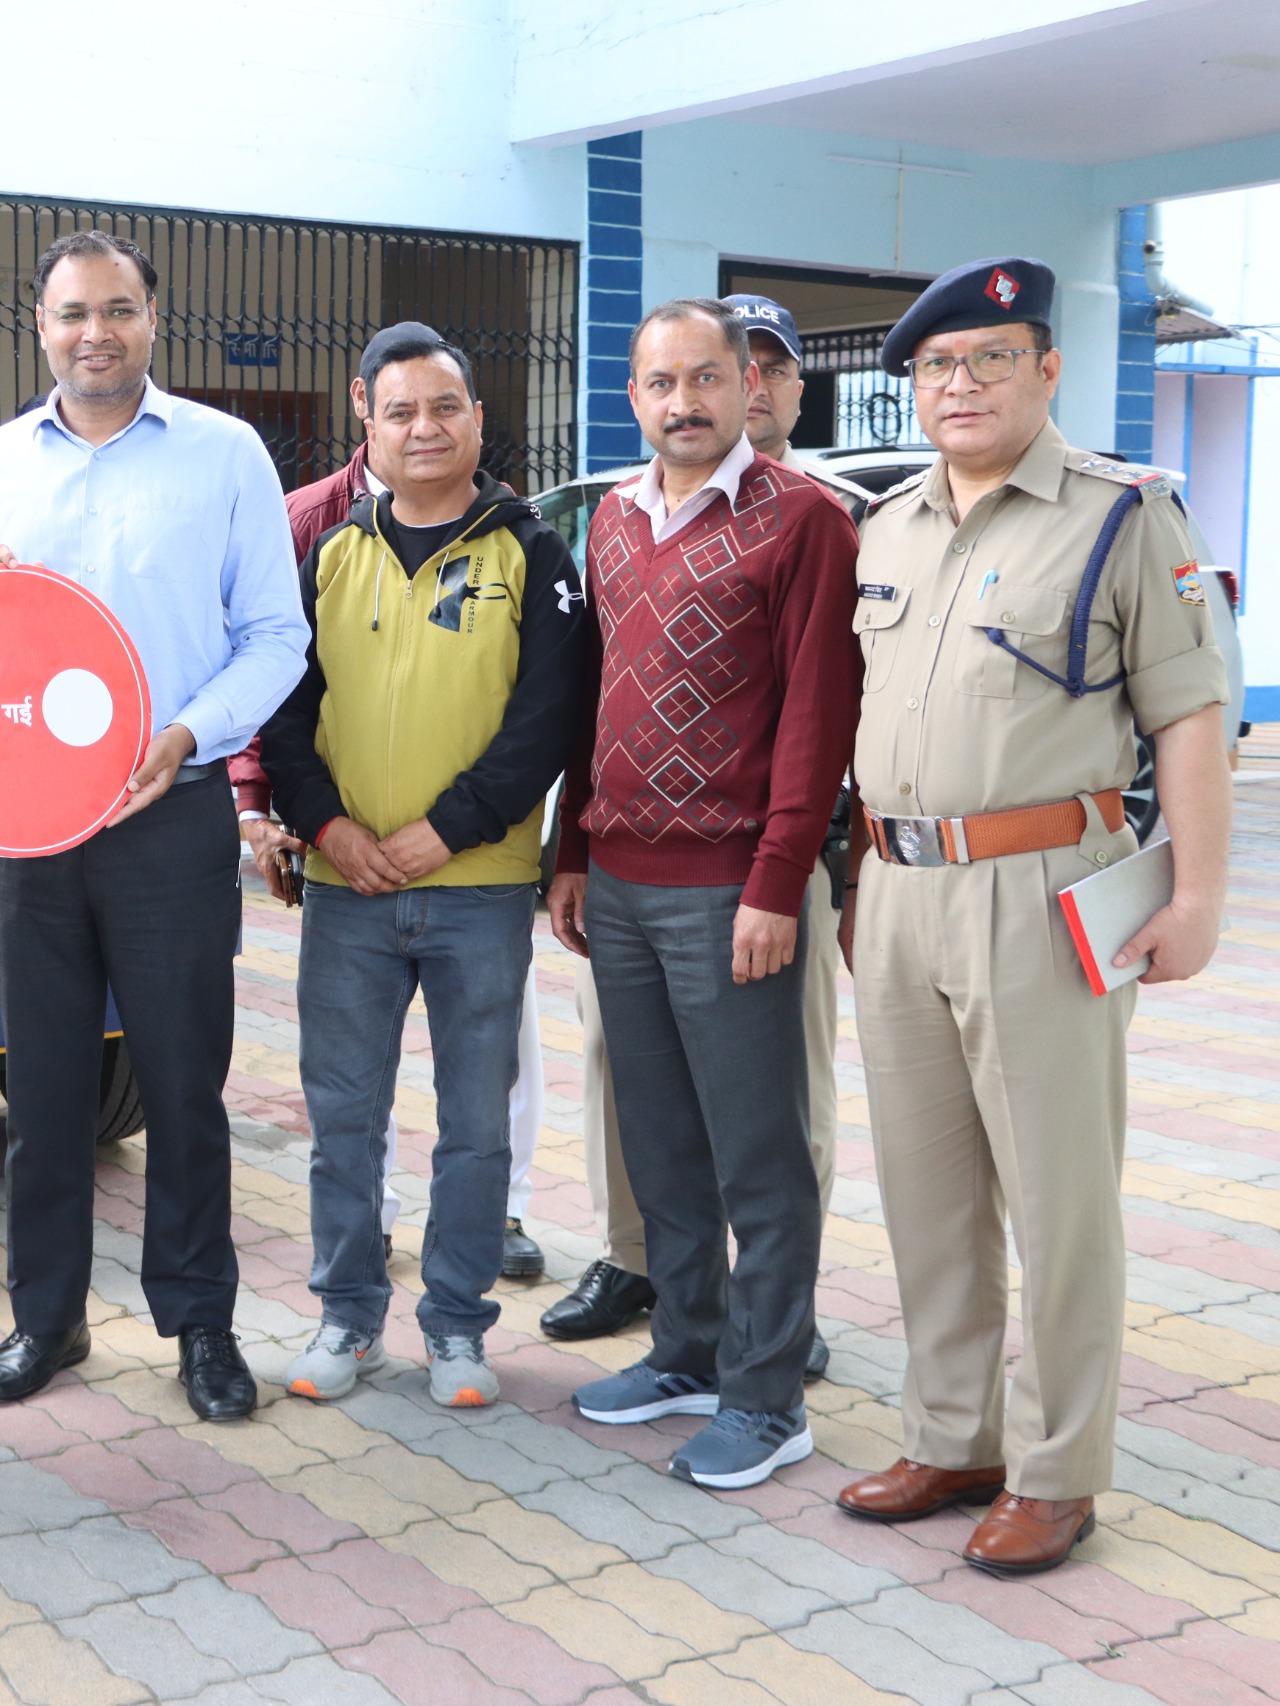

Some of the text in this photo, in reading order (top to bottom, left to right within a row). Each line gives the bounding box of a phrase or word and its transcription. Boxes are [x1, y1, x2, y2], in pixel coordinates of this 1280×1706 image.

[733, 304, 780, 324] OLICE
[472, 556, 484, 585] UNDER
[467, 600, 476, 634] ARMOUR
[1, 695, 33, 727] गई
